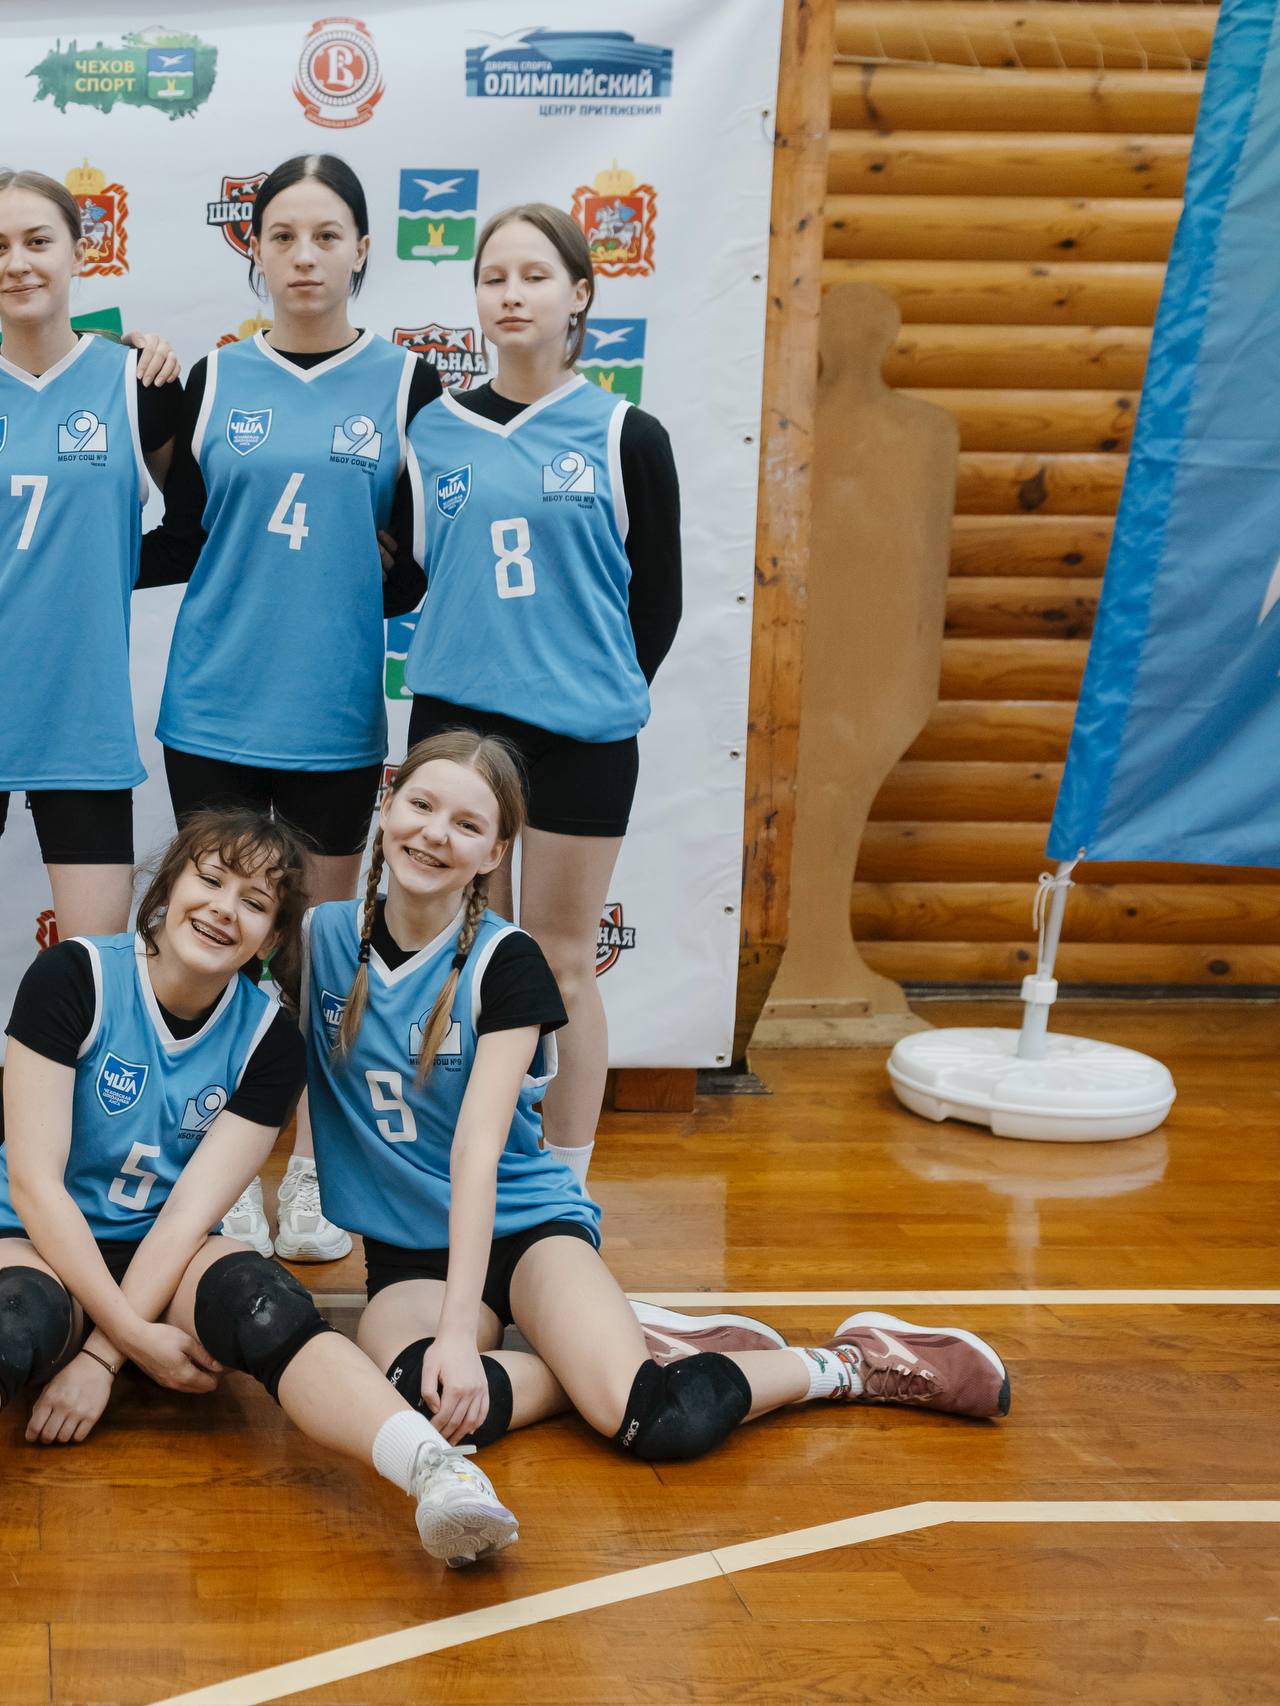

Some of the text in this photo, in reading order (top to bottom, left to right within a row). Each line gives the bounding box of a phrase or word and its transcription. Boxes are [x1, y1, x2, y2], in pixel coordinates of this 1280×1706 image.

[75, 59, 136, 74] ЧЕХОВ
[484, 61, 553, 73] ДВОРЕЦ СПОРТА
[74, 77, 137, 92] СПОРТ
[484, 68, 654, 97] ОЛИМПИЙСКИЙ
[539, 103, 662, 117] ЦЕНТР ПРИТЯЖЕНИЯ
[231, 422, 264, 434] ЧШЛ
[58, 454, 77, 462] МБОУ
[350, 458, 367, 467] СОШ
[439, 479, 466, 499] ЧШЛ
[10, 474, 49, 550] 7
[267, 472, 310, 550] 4
[490, 516, 536, 600] 8
[103, 1070, 137, 1096] ЧШЛ
[365, 1070, 418, 1143] 9
[107, 1140, 161, 1211] 5
